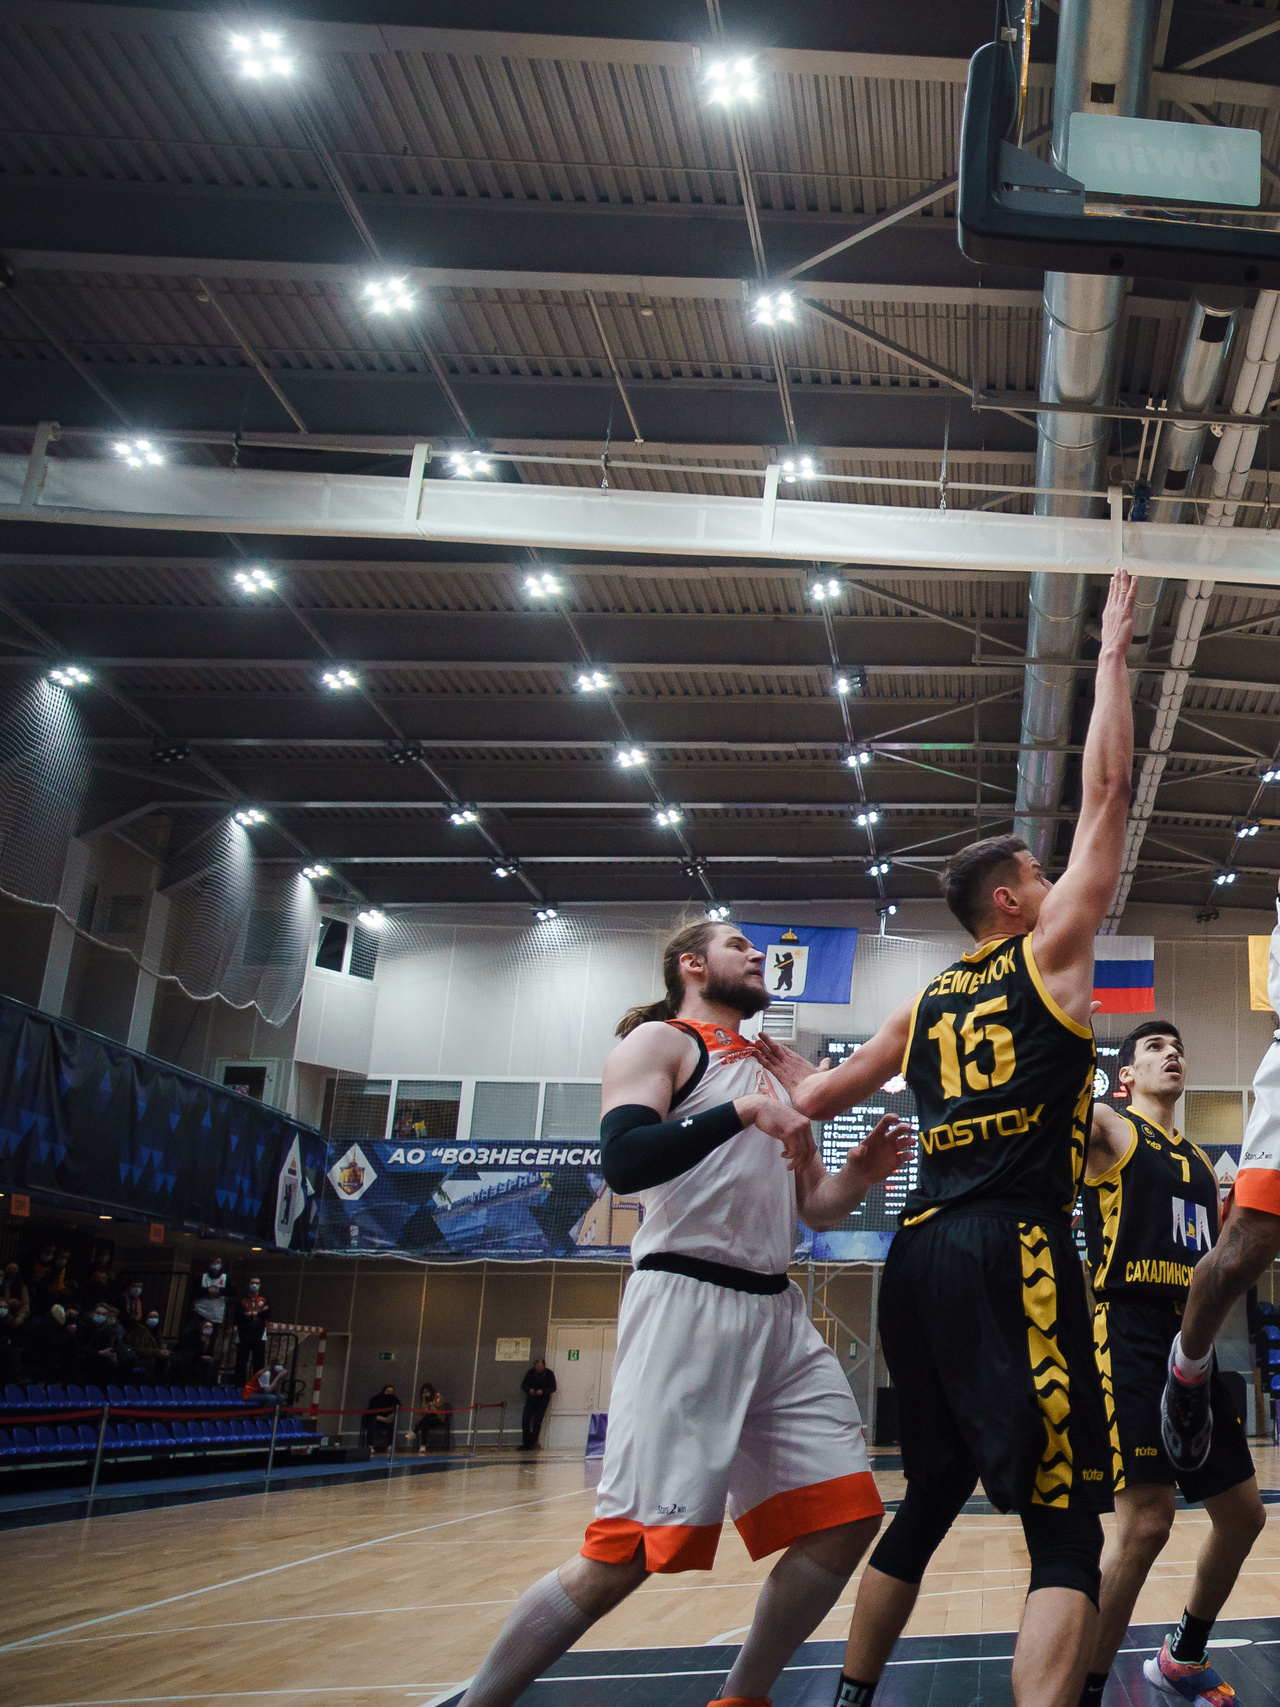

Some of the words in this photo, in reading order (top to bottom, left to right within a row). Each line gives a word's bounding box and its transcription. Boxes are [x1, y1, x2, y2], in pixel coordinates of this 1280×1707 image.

[929, 995, 1017, 1099] 15
[919, 1104, 1046, 1154] VOSTOK
[388, 1148, 425, 1165] АО
[432, 1147, 601, 1166] “ВОЗНЕСЕНСК
